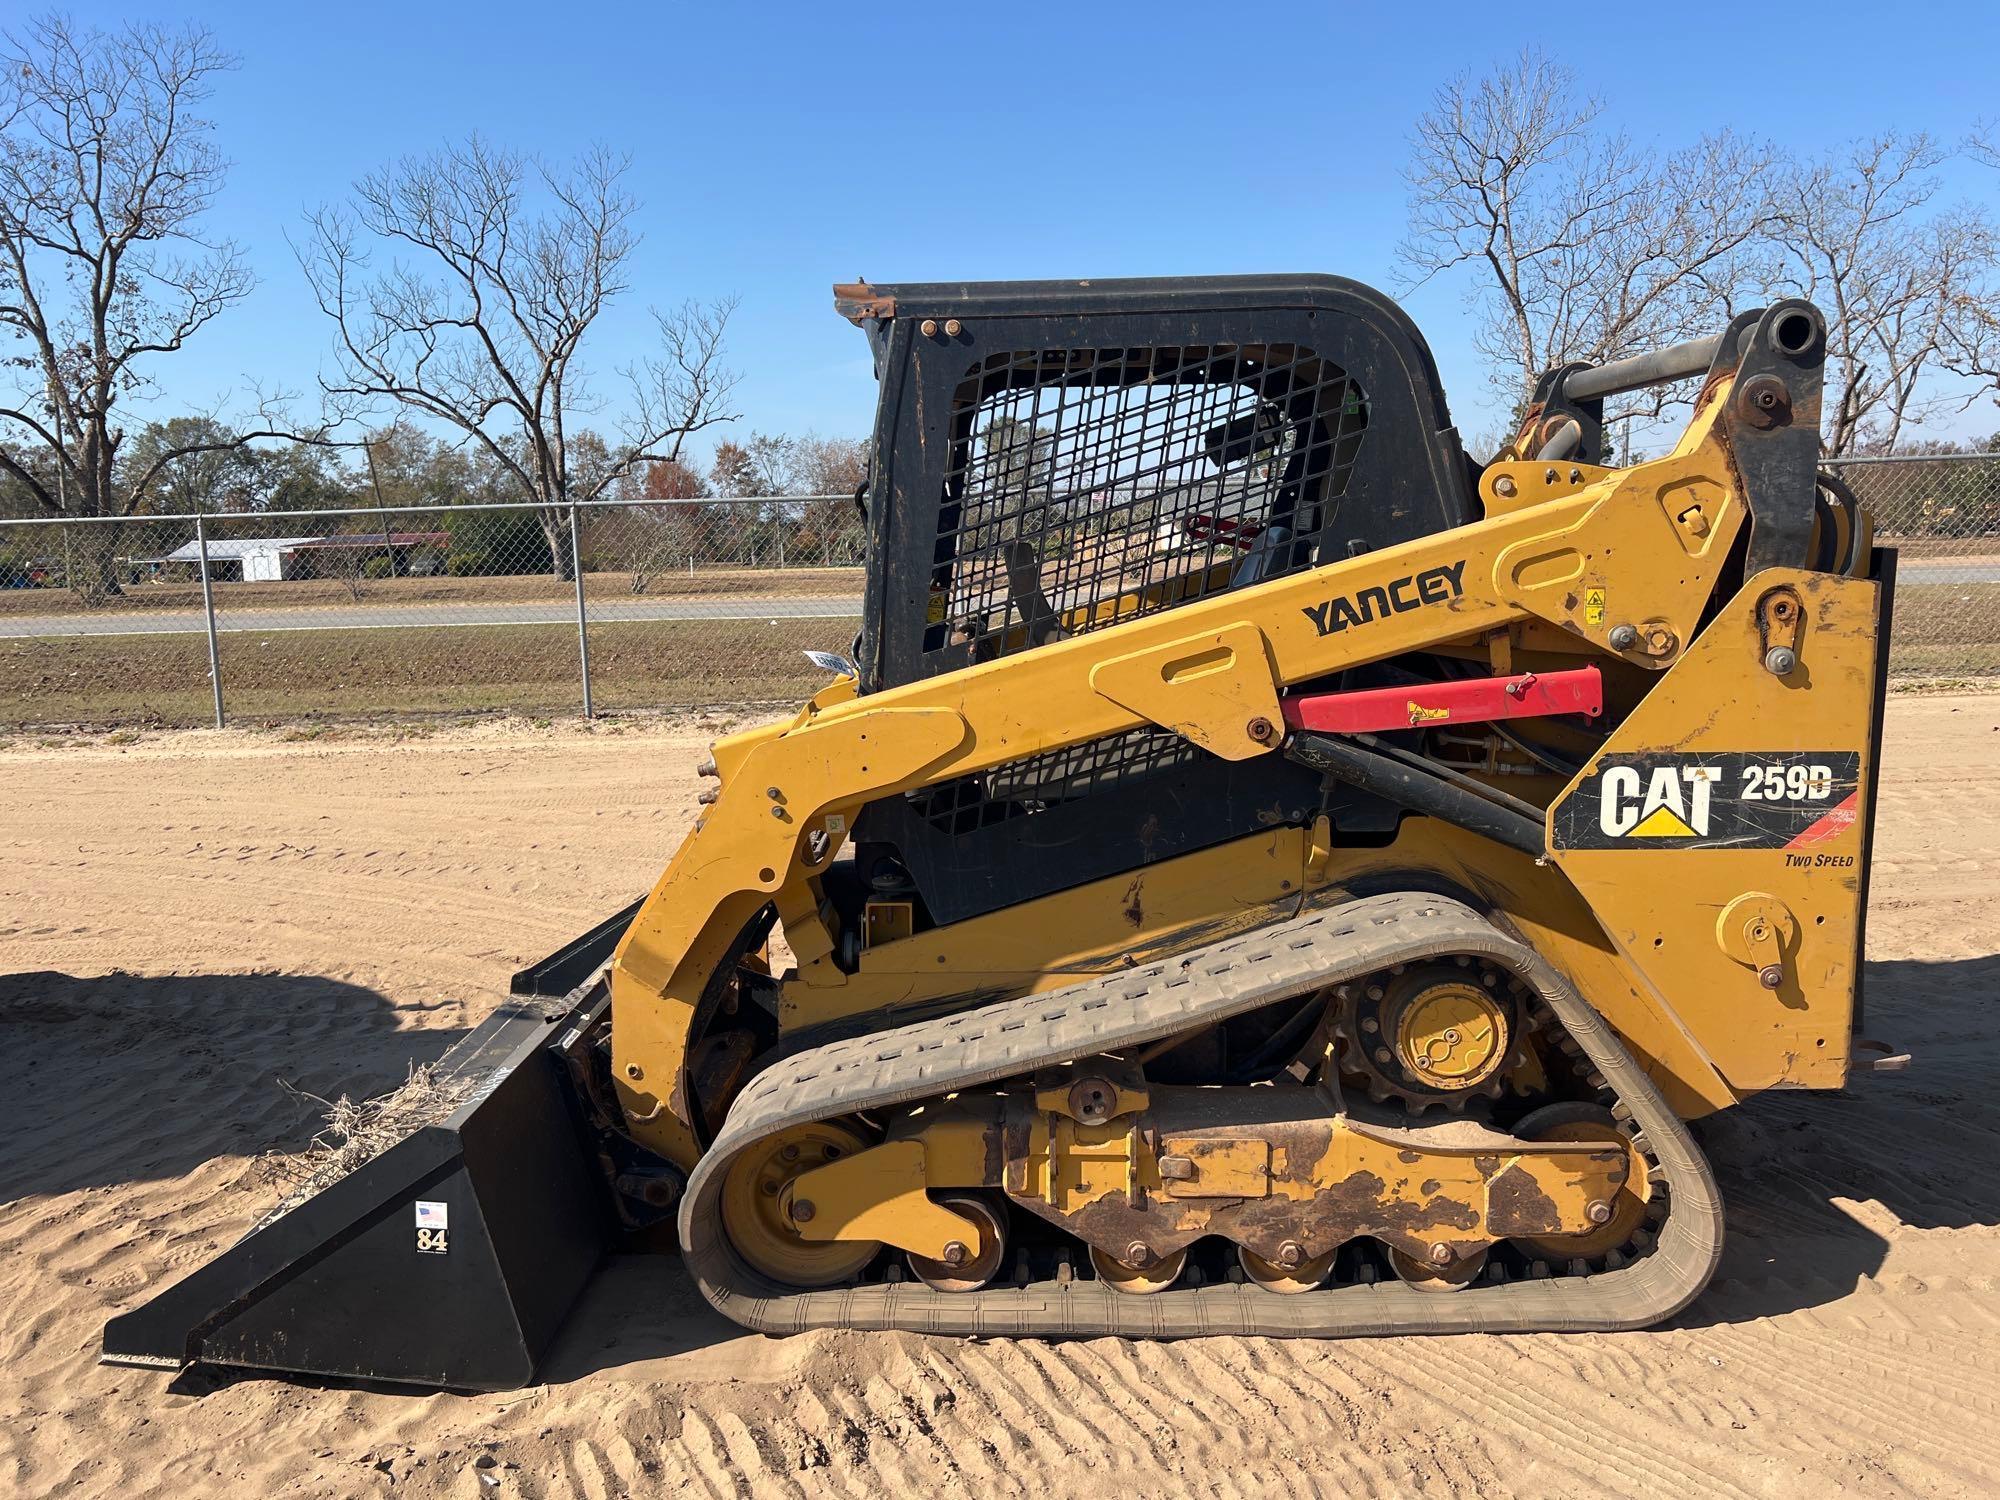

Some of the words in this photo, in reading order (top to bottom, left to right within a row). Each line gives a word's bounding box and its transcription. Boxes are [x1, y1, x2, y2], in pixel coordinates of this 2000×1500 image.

[1301, 560, 1466, 637] YANCEY
[1741, 765, 1833, 801] 259D
[1600, 766, 1722, 837] CAT
[1785, 853, 1812, 867] TWO
[1815, 853, 1854, 867] SPEED
[417, 1228, 448, 1252] 84
